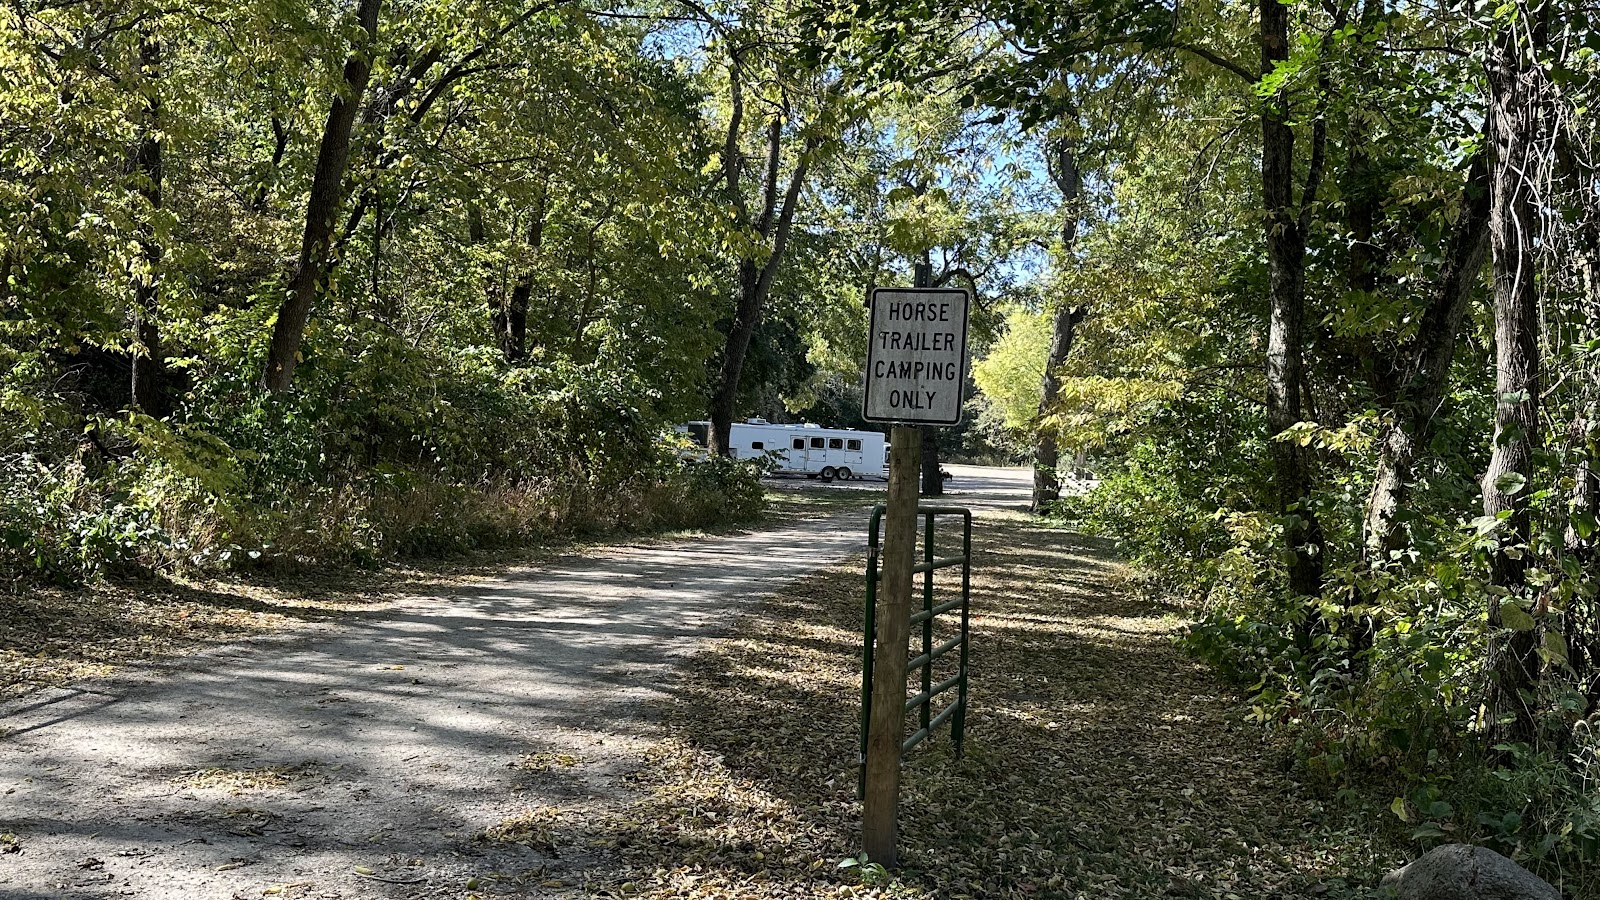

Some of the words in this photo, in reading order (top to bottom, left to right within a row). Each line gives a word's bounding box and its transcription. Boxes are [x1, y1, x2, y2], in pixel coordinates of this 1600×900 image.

[889, 302, 950, 322] HORSE
[879, 331, 955, 351] TRAILER
[875, 360, 956, 381] CAMPING
[889, 389, 937, 410] ONLY
